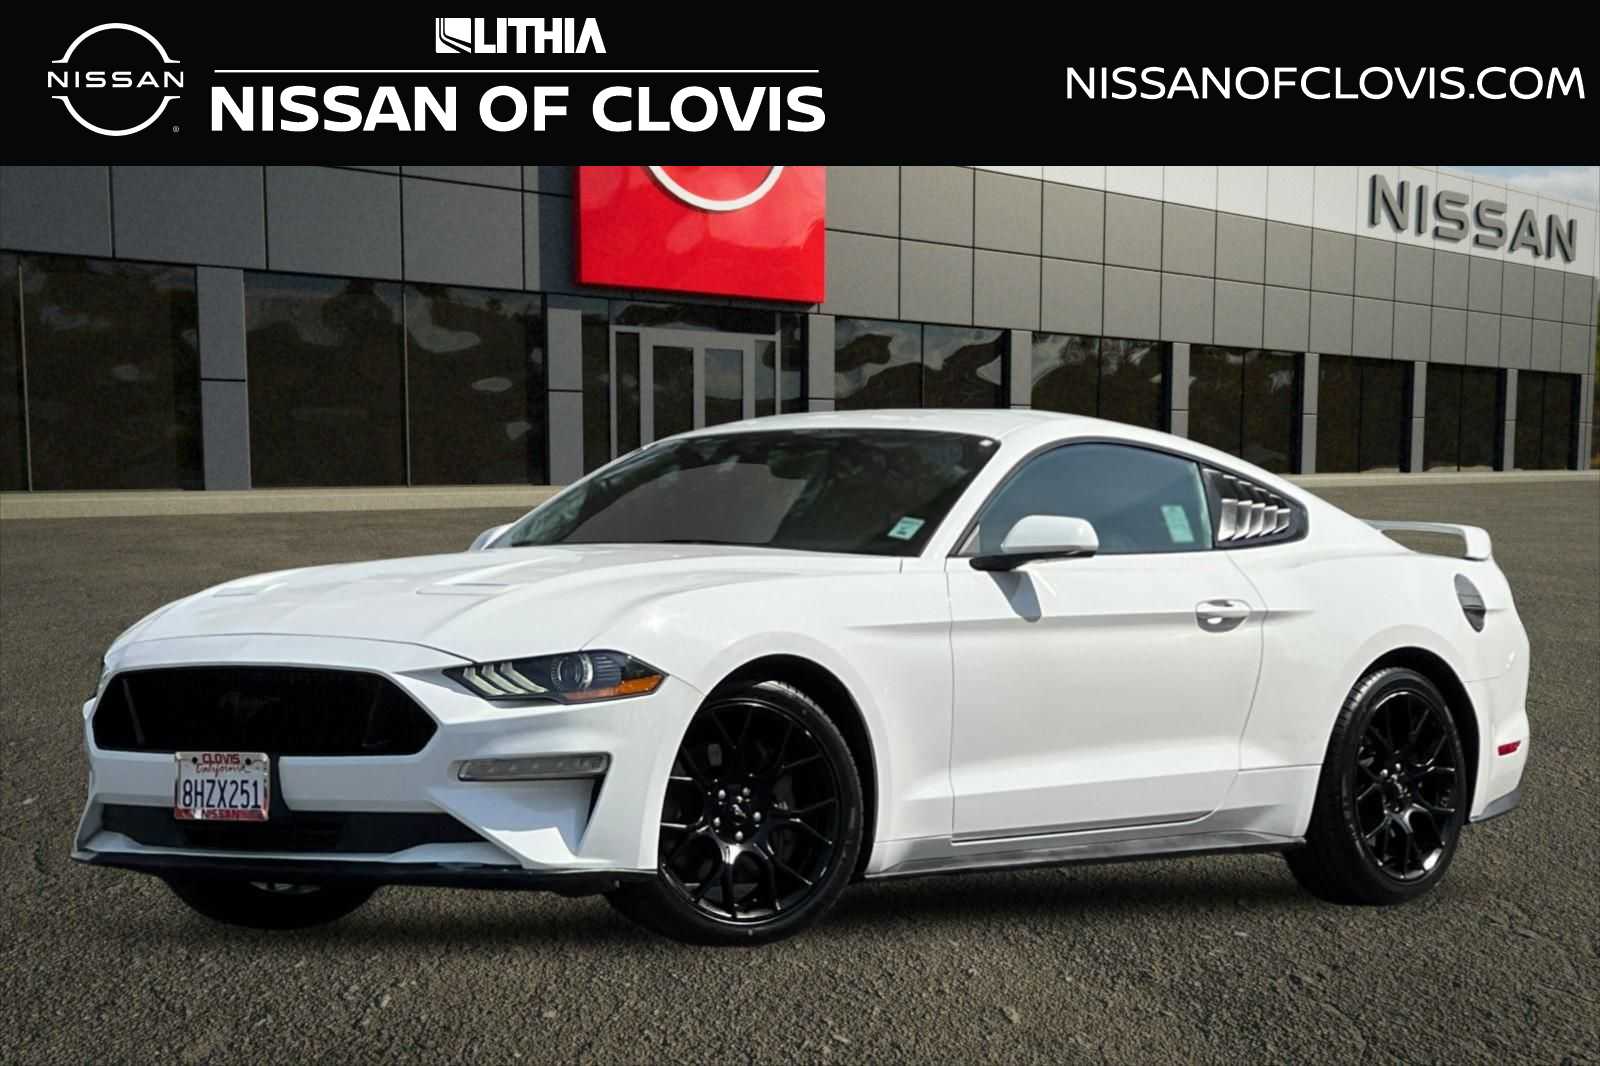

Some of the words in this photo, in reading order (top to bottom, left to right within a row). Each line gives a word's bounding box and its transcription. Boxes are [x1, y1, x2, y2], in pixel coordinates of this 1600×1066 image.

[1368, 174, 1578, 263] NISSAN
[202, 753, 241, 764] CLOVIS
[182, 779, 262, 809] 8HZX251
